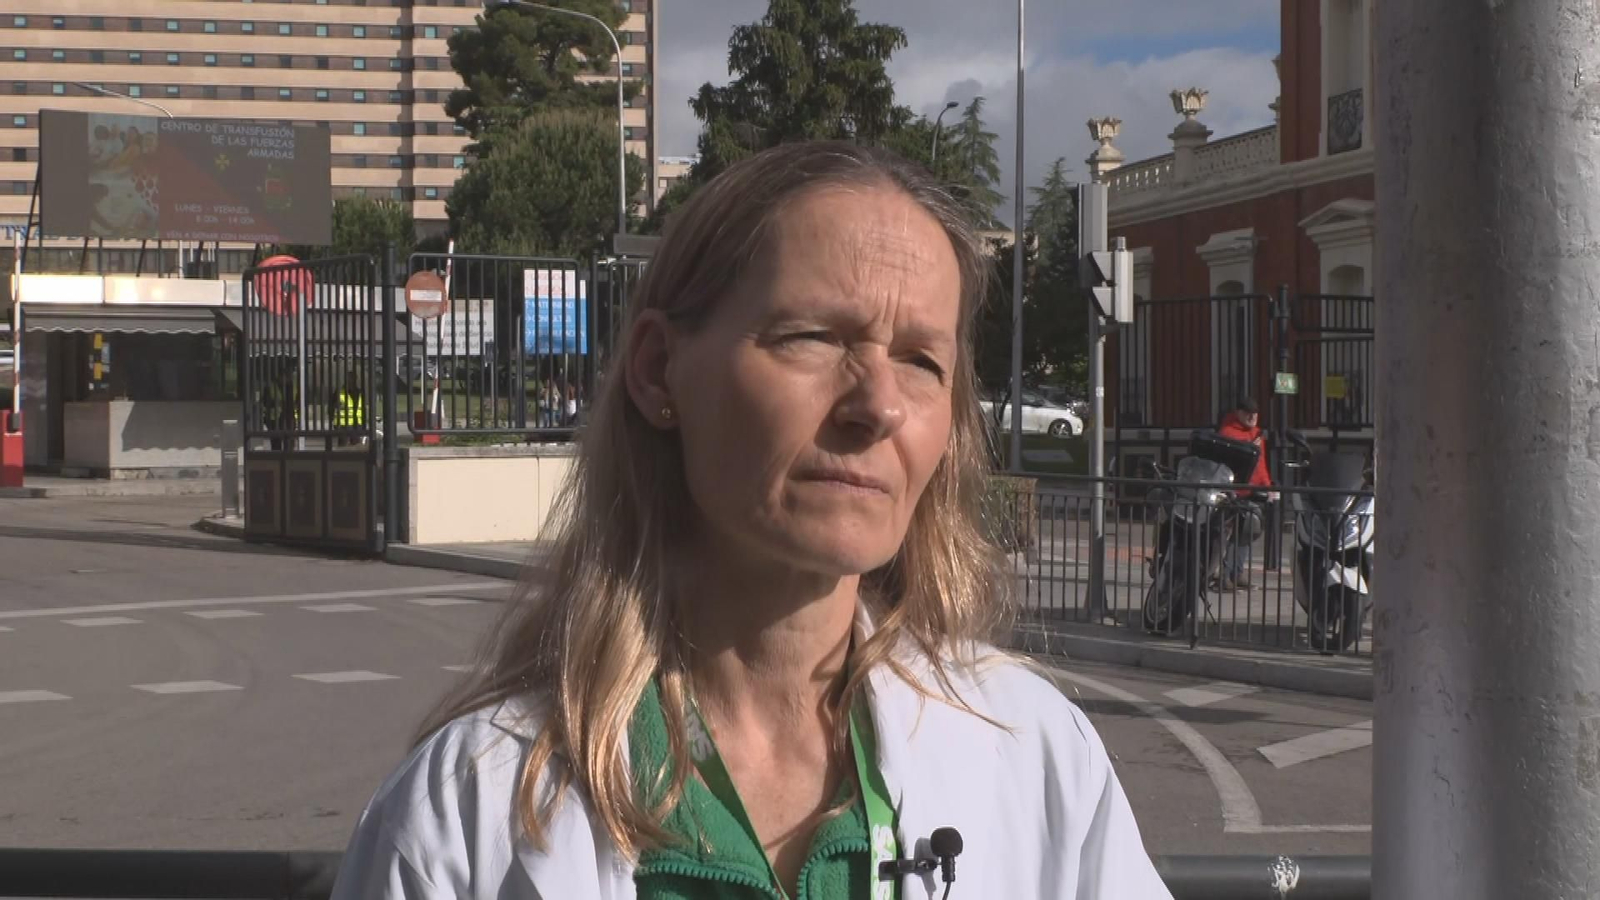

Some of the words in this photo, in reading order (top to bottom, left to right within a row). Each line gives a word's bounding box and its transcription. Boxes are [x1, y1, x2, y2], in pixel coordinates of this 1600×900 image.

[160, 120, 201, 133] CENTRO
[205, 124, 218, 134] DE
[222, 125, 295, 138] TRANSFUSIÓN
[211, 135, 225, 145] DE
[227, 136, 247, 146] LAS
[250, 137, 295, 149] FUERZAS
[247, 149, 295, 160] ARMADAS
[174, 203, 202, 213] LUNES
[213, 205, 250, 214] VIERNES
